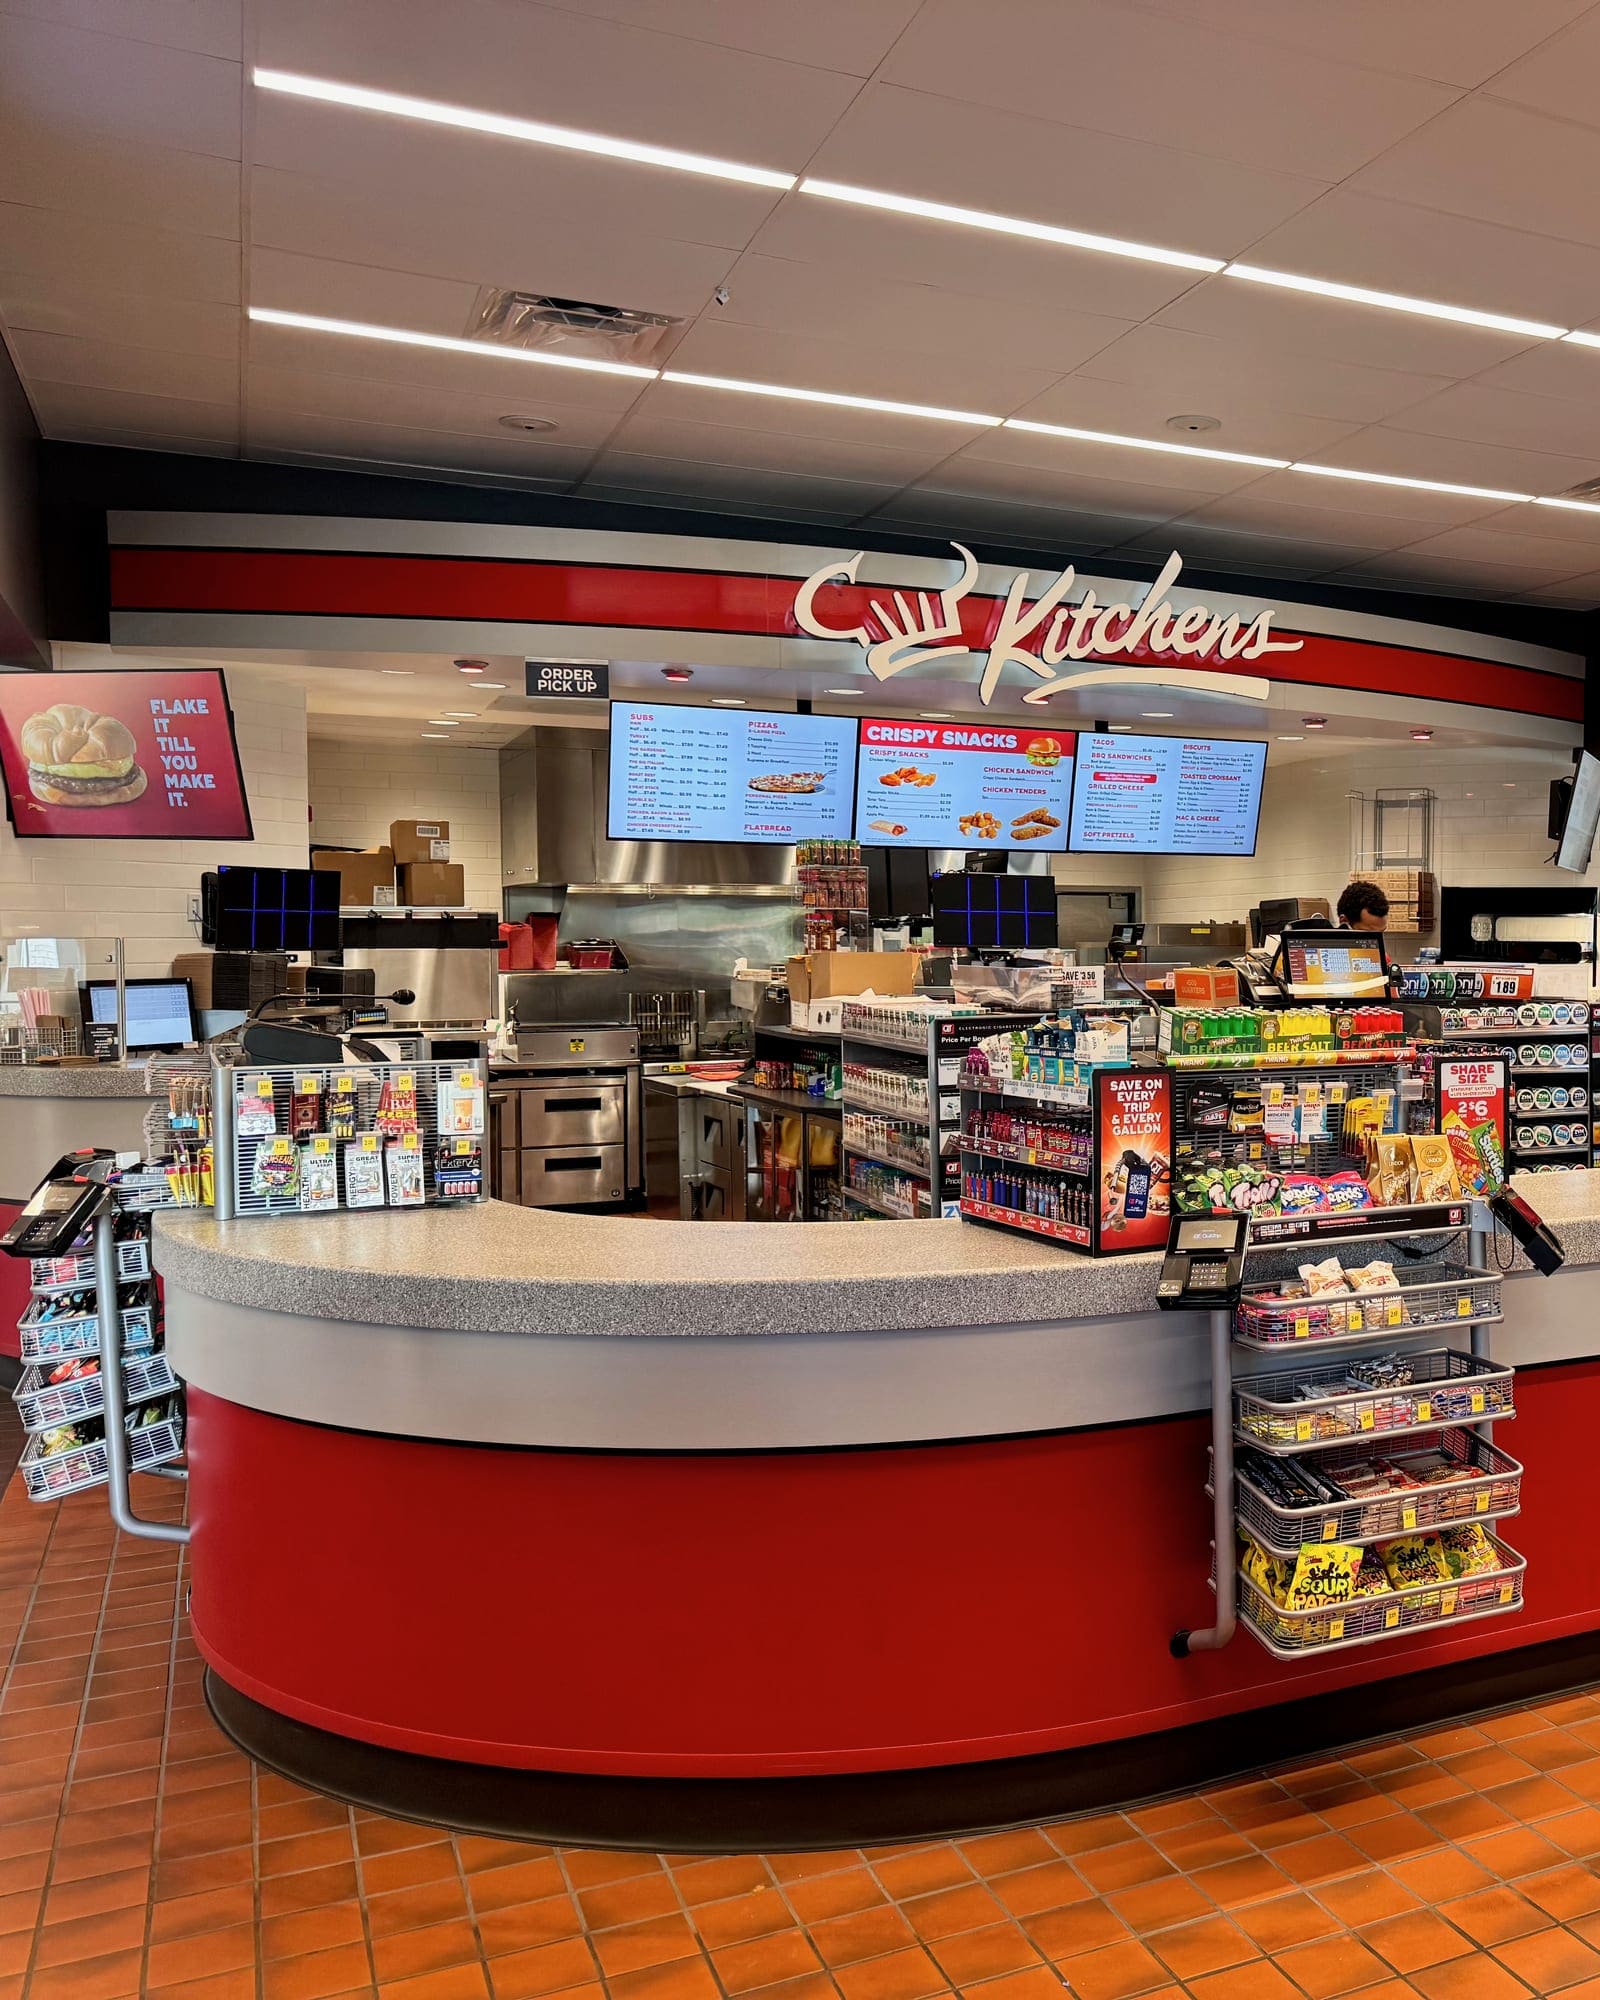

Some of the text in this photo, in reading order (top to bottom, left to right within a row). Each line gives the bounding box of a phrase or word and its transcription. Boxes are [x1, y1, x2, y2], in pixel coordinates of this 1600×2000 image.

[980, 550, 1303, 705] Kitchens
[541, 668, 593, 680] ORDER
[538, 680, 597, 692] PICK UP
[150, 699, 209, 714] FLAKE
[630, 713, 654, 721] SUBS
[153, 718, 170, 733] IT
[748, 721, 778, 729] PIZZAS
[156, 736, 196, 751] TILL
[867, 726, 1018, 749] CRISPY SNACKS
[1092, 738, 1116, 746] TACOS
[869, 750, 897, 758] CRISPY
[1107, 753, 1153, 761] SANDWICHES
[160, 755, 197, 770] YOU
[983, 766, 1054, 776] CHICKEN SANDWICH
[164, 774, 216, 788] MAKE
[982, 786, 1013, 794] CHICKEN
[168, 792, 188, 806] IT.
[744, 824, 792, 832] FLATBREAD
[941, 1036, 959, 1044] Price
[960, 1035, 971, 1043] Per
[1212, 1032, 1384, 1045] TWANG TWANG TWANG
[1342, 1039, 1402, 1050] BEER SALT
[1189, 1042, 1257, 1055] BEER SALT
[1267, 1041, 1330, 1052] BEER SALT
[1265, 1055, 1289, 1064] TWANG
[1345, 1053, 1370, 1061] TWANG
[1450, 1064, 1495, 1075] SHARE
[1110, 1079, 1162, 1091] SAVE ON
[1458, 1074, 1487, 1084] SIZE
[1117, 1090, 1157, 1102] EVERY
[391, 1099, 414, 1110] B12
[1123, 1102, 1151, 1113] TRIP
[1458, 1100, 1489, 1117] 2 $6
[1112, 1112, 1162, 1125] & EVERY
[1112, 1123, 1161, 1136] GALLON
[1478, 1134, 1504, 1184] Skittles
[947, 1163, 960, 1172] QT
[1231, 1178, 1280, 1210] Trolli
[1401, 1565, 1440, 1581] PATCH
[1301, 1578, 1348, 1596] SOUR
